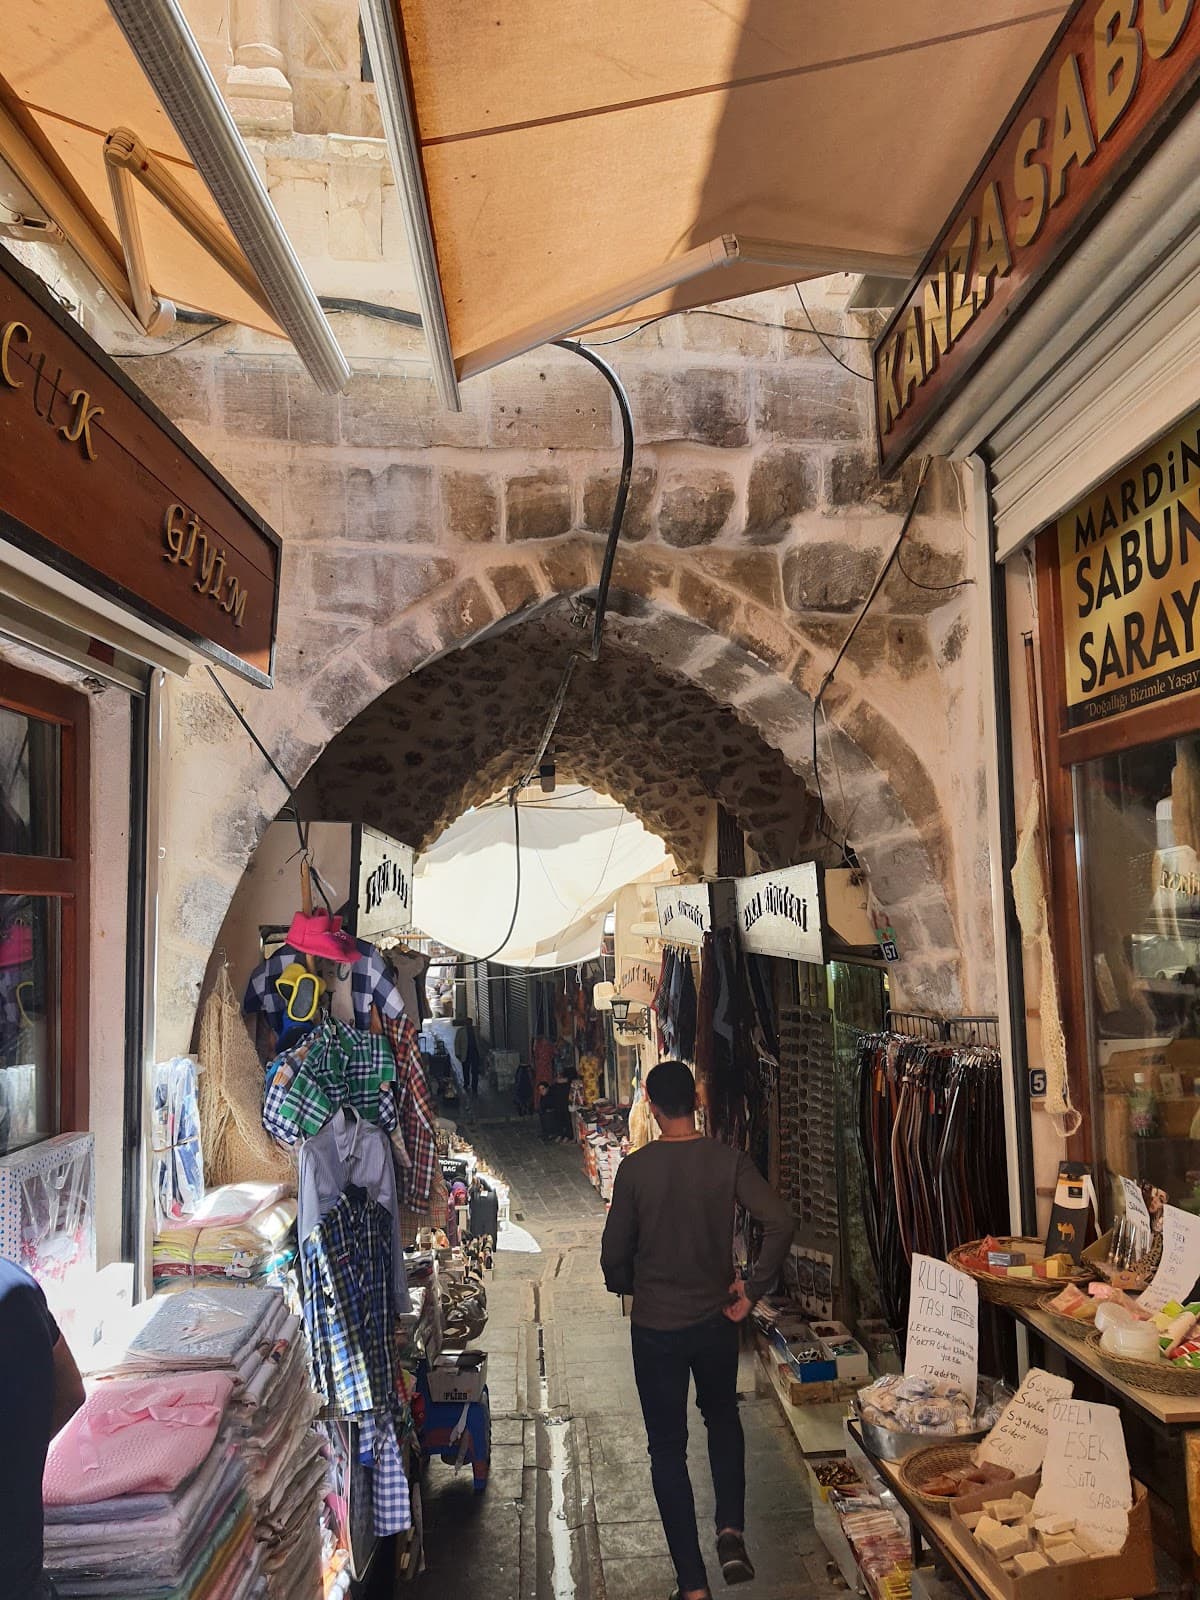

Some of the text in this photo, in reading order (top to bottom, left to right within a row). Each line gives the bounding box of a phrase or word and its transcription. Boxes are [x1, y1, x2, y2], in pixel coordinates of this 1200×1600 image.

[879, 182, 1016, 435] KANZA
[1078, 581, 1200, 694] SARAY
[1129, 679, 1166, 704] Bizimle
[884, 944, 897, 959] 57
